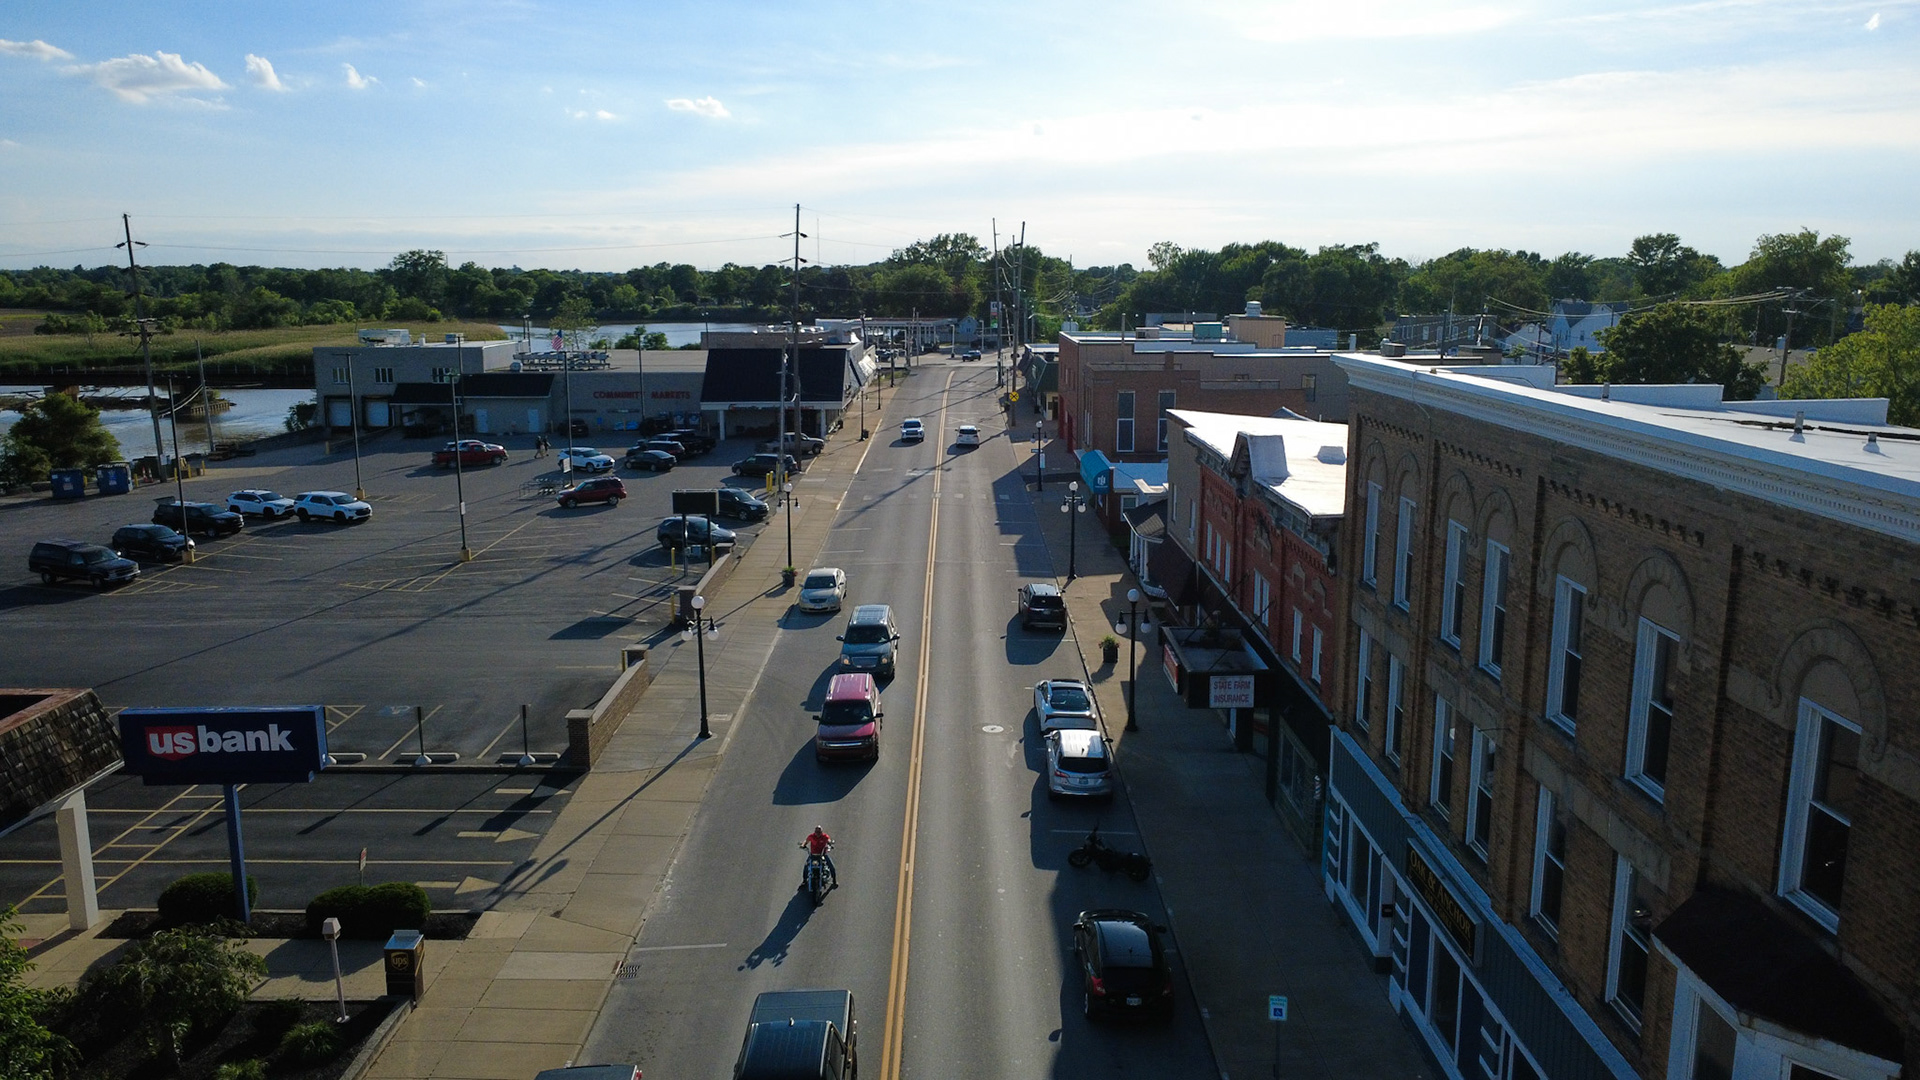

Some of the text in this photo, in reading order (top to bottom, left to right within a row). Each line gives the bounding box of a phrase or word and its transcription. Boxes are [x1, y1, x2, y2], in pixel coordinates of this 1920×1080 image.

[651, 391, 690, 399] MARKETS
[1213, 681, 1251, 690] STATE FARM
[1213, 694, 1249, 703] INSURANCE
[1427, 872, 1436, 891] &
[1437, 885, 1471, 939] ANCHOR
